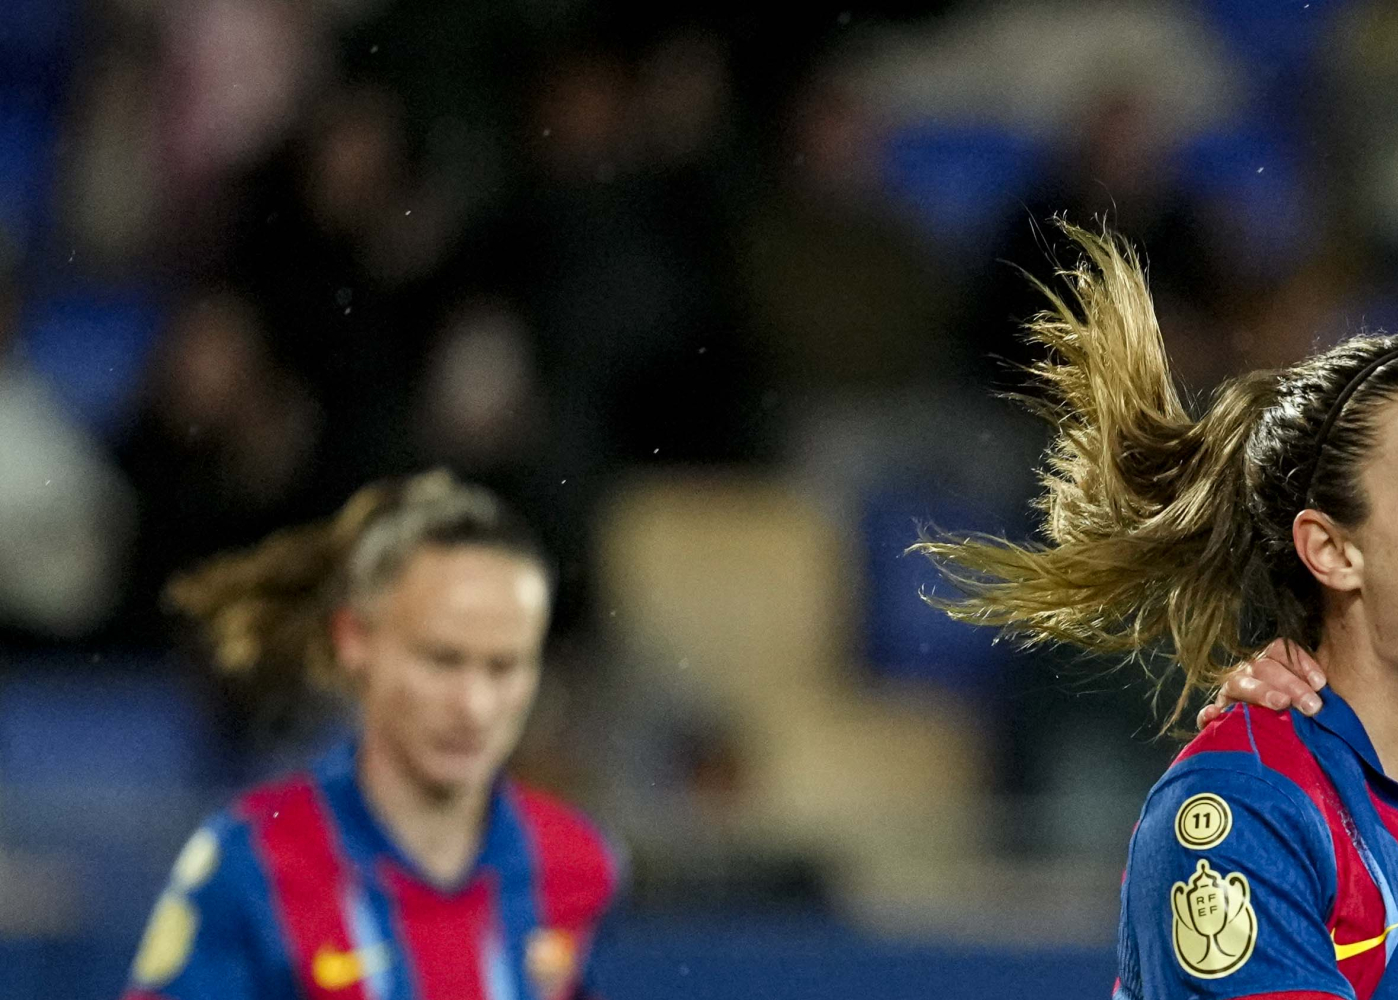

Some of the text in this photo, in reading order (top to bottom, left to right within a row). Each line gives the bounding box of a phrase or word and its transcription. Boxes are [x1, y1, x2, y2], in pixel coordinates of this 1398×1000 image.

[1193, 812, 1211, 829] 11
[1196, 893, 1216, 905] RF
[1198, 905, 1218, 917] EF
